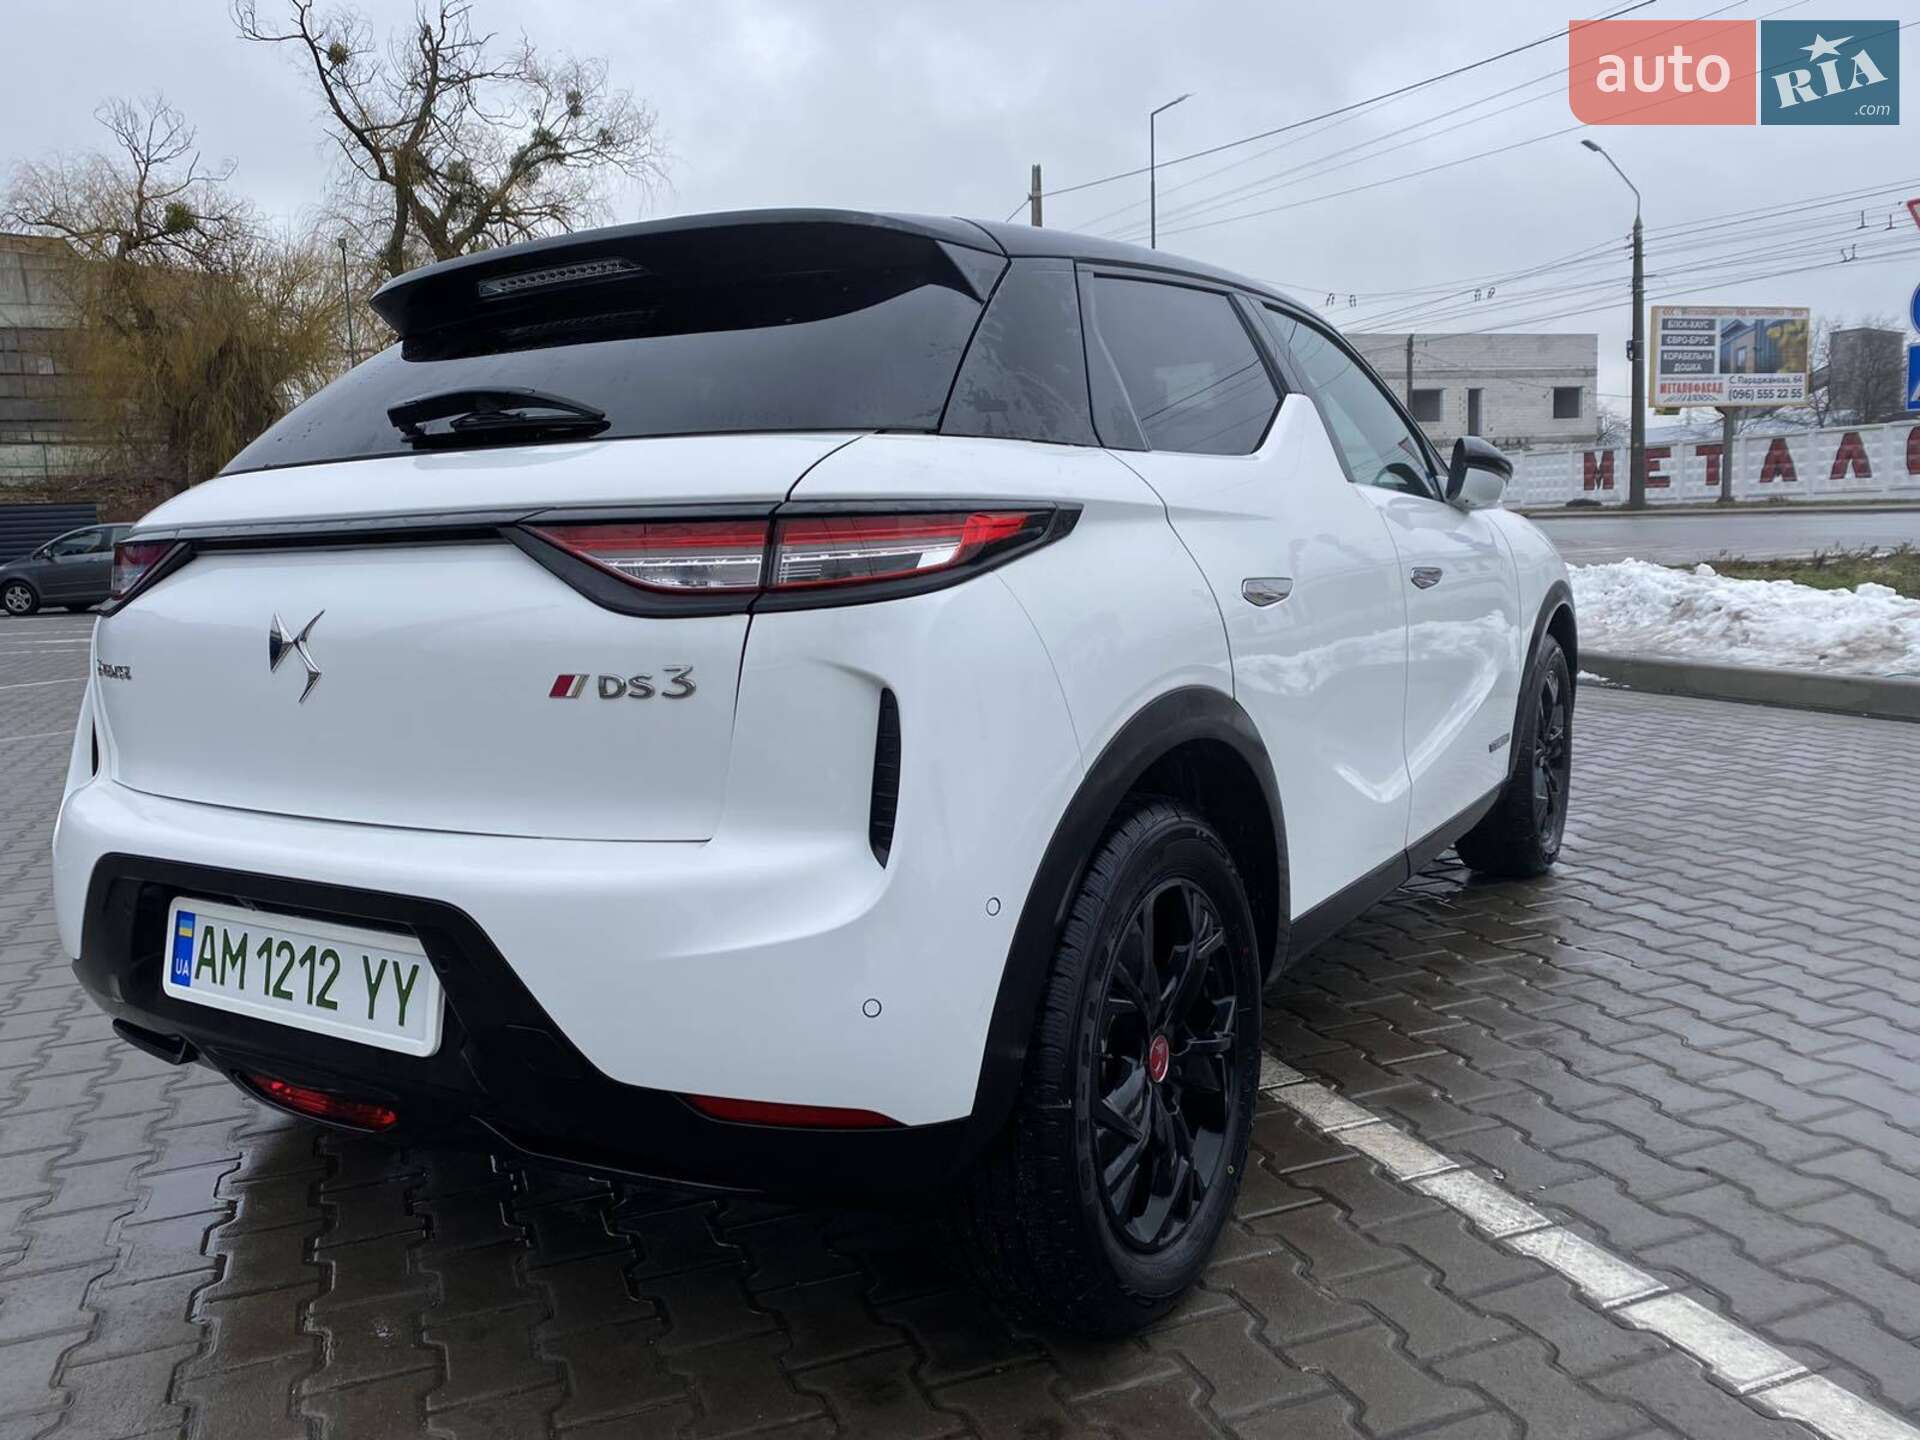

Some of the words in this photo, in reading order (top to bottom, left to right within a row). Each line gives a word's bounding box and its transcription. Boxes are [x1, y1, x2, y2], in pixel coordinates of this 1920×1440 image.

[1663, 351, 1713, 361] КОРАБЕЛЬНА
[1673, 362, 1703, 373] ДОШКА
[1728, 388, 1755, 401] (096)
[1757, 388, 1775, 400] 555
[1777, 388, 1789, 399] 22
[1790, 388, 1803, 399] 55
[175, 958, 190, 977] UA
[194, 925, 249, 990] AM
[256, 937, 341, 1010] 1212
[362, 955, 420, 1027] YY
